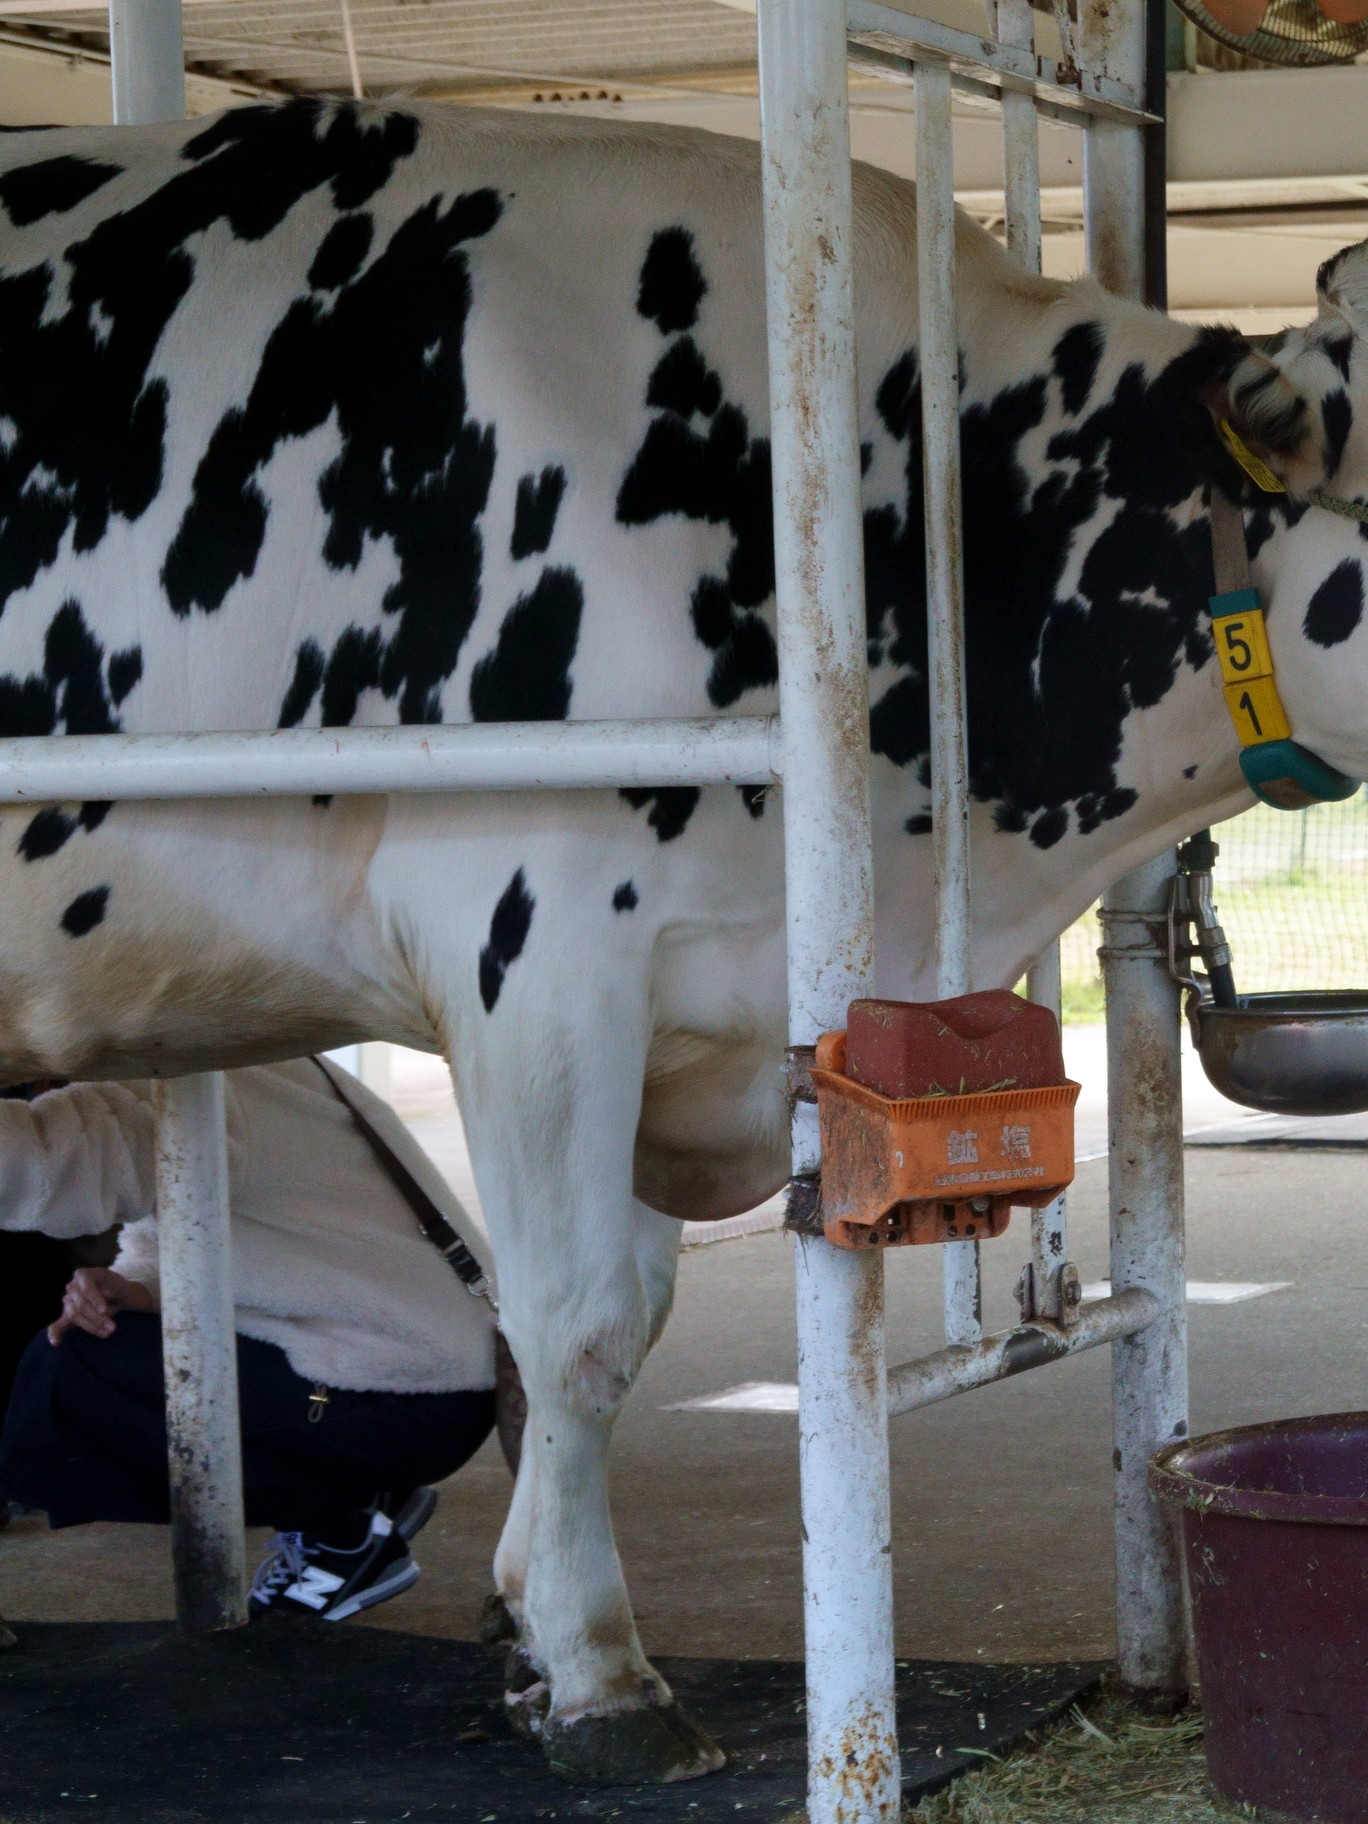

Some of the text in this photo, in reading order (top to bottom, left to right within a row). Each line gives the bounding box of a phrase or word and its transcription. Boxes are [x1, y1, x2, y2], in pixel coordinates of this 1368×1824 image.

[1224, 622, 1262, 737] 5 1
[283, 1565, 346, 1611] N
